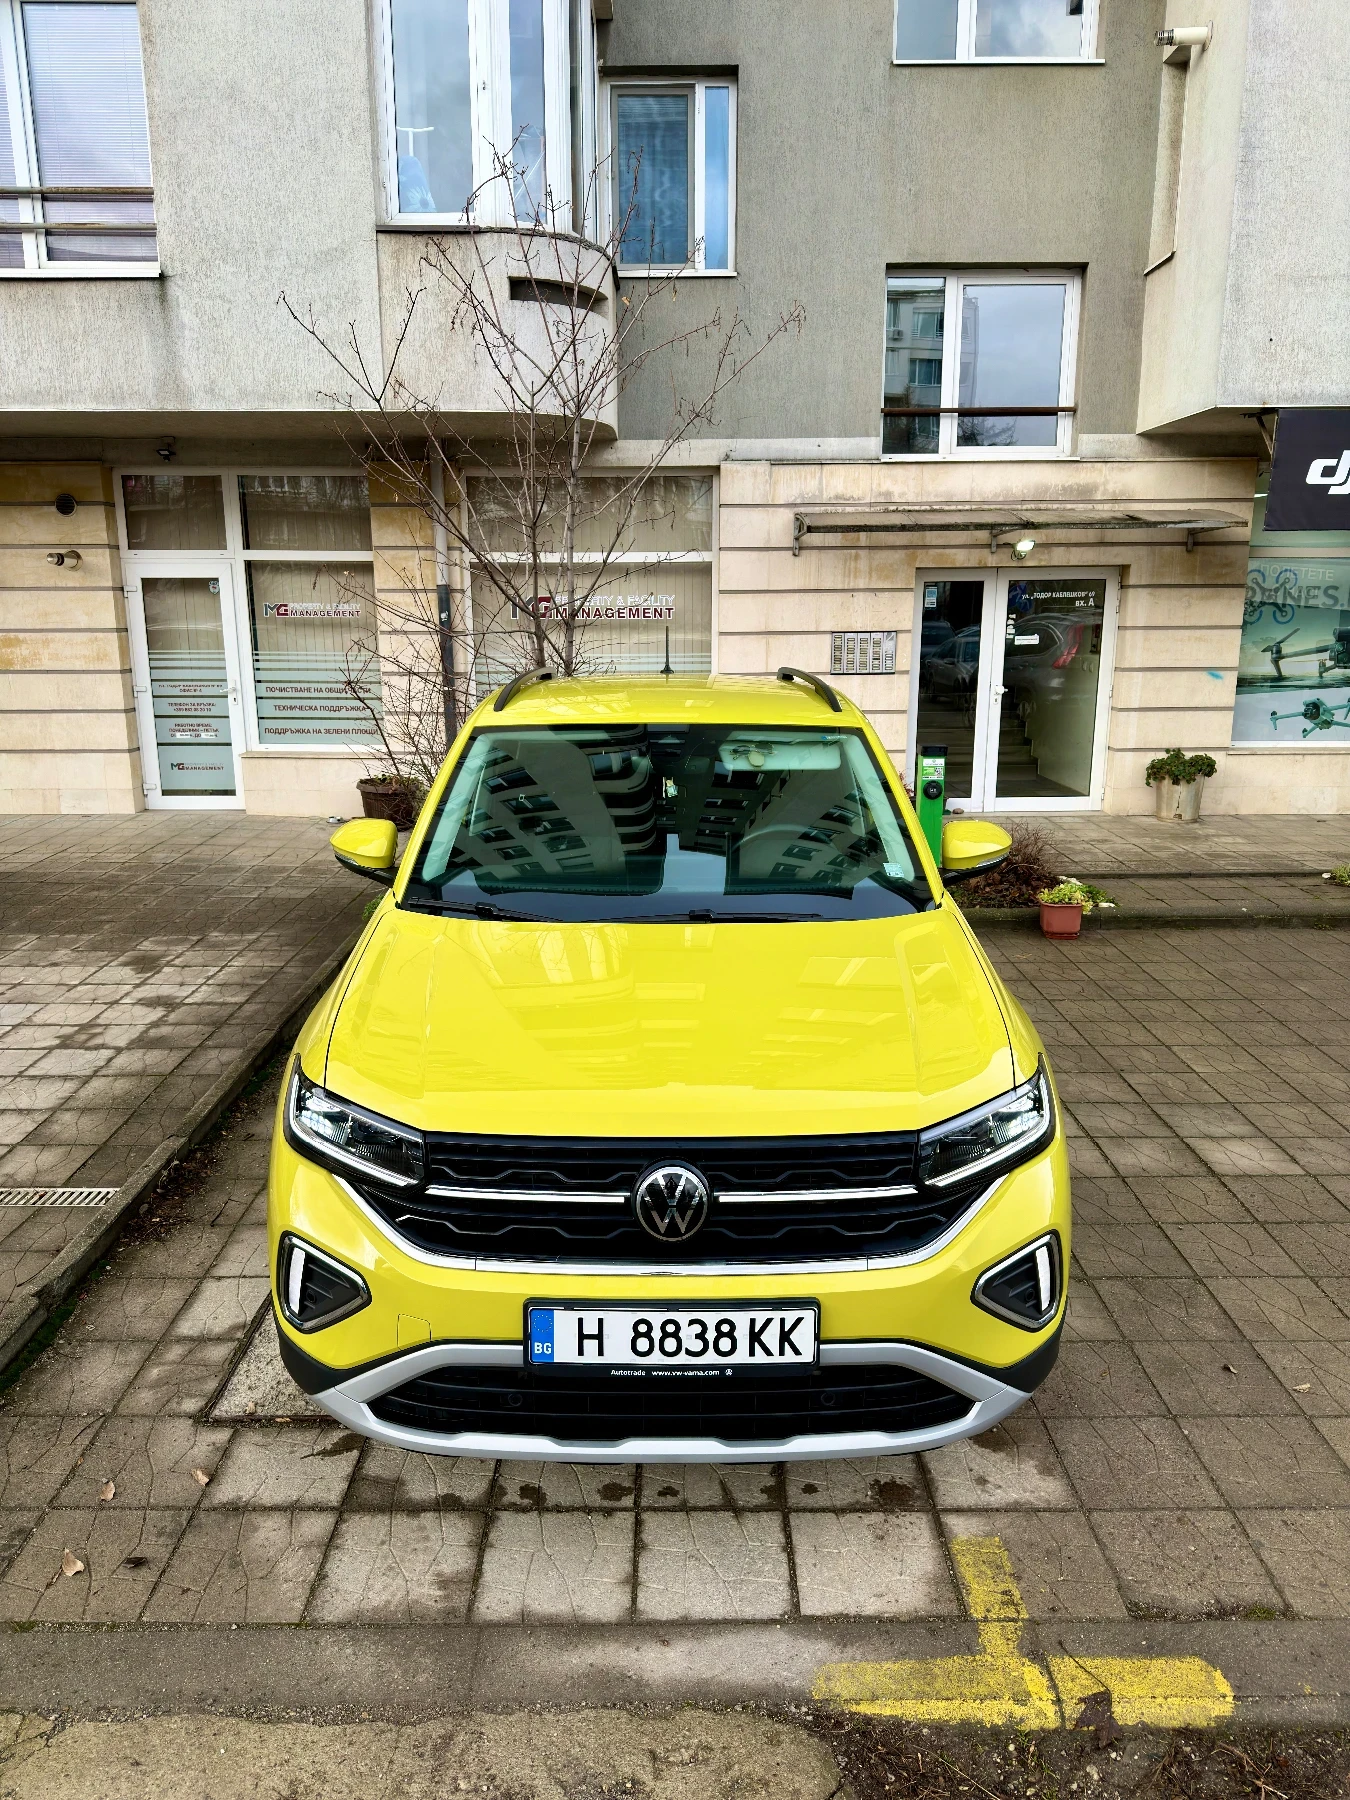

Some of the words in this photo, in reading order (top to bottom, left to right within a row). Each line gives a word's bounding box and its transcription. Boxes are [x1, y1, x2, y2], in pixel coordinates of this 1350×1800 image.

[627, 595, 676, 606] FACILITY
[320, 705, 366, 713] ПОДДРЪЖКА
[577, 1317, 605, 1357] H
[630, 1318, 738, 1358] 8838
[749, 1316, 805, 1357] KK
[533, 1342, 552, 1354] BG
